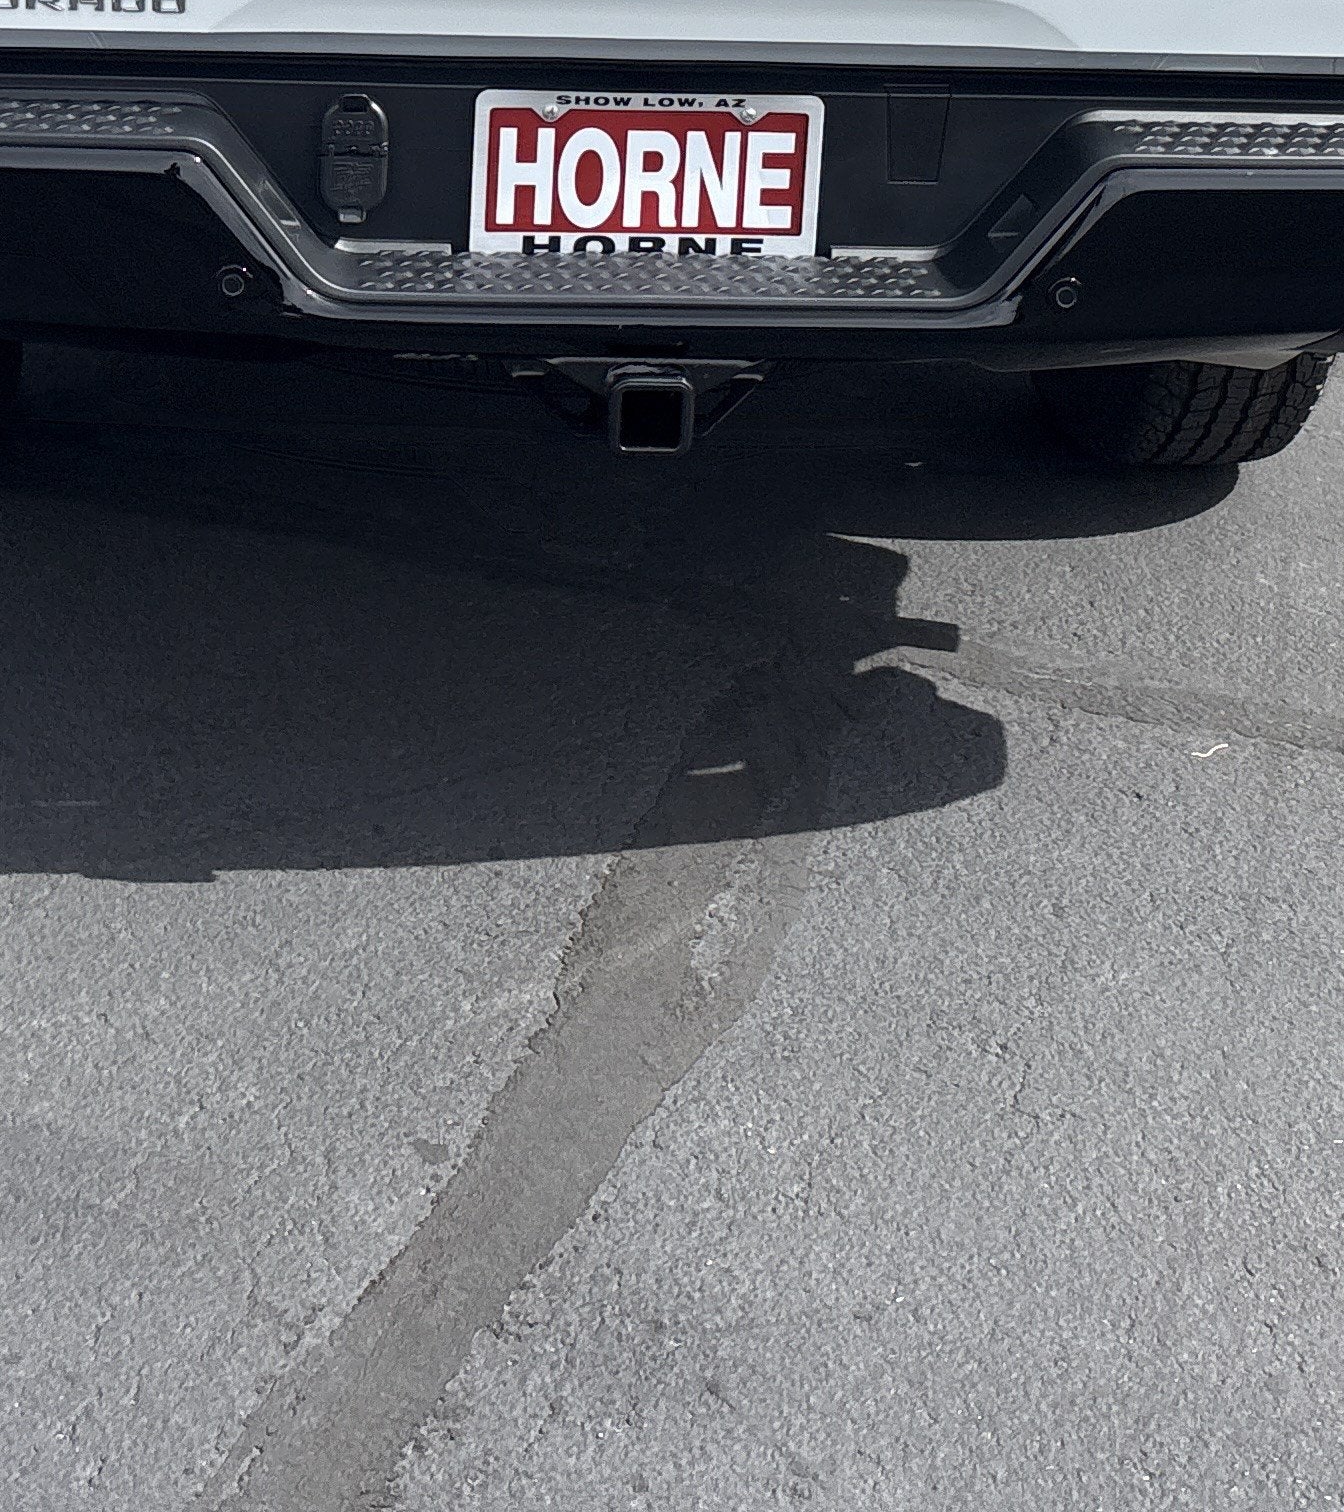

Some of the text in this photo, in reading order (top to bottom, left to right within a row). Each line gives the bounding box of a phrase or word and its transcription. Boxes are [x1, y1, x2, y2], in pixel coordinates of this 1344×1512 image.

[556, 95, 747, 108] SHOW LOW, AZ
[496, 127, 796, 229] HORNE
